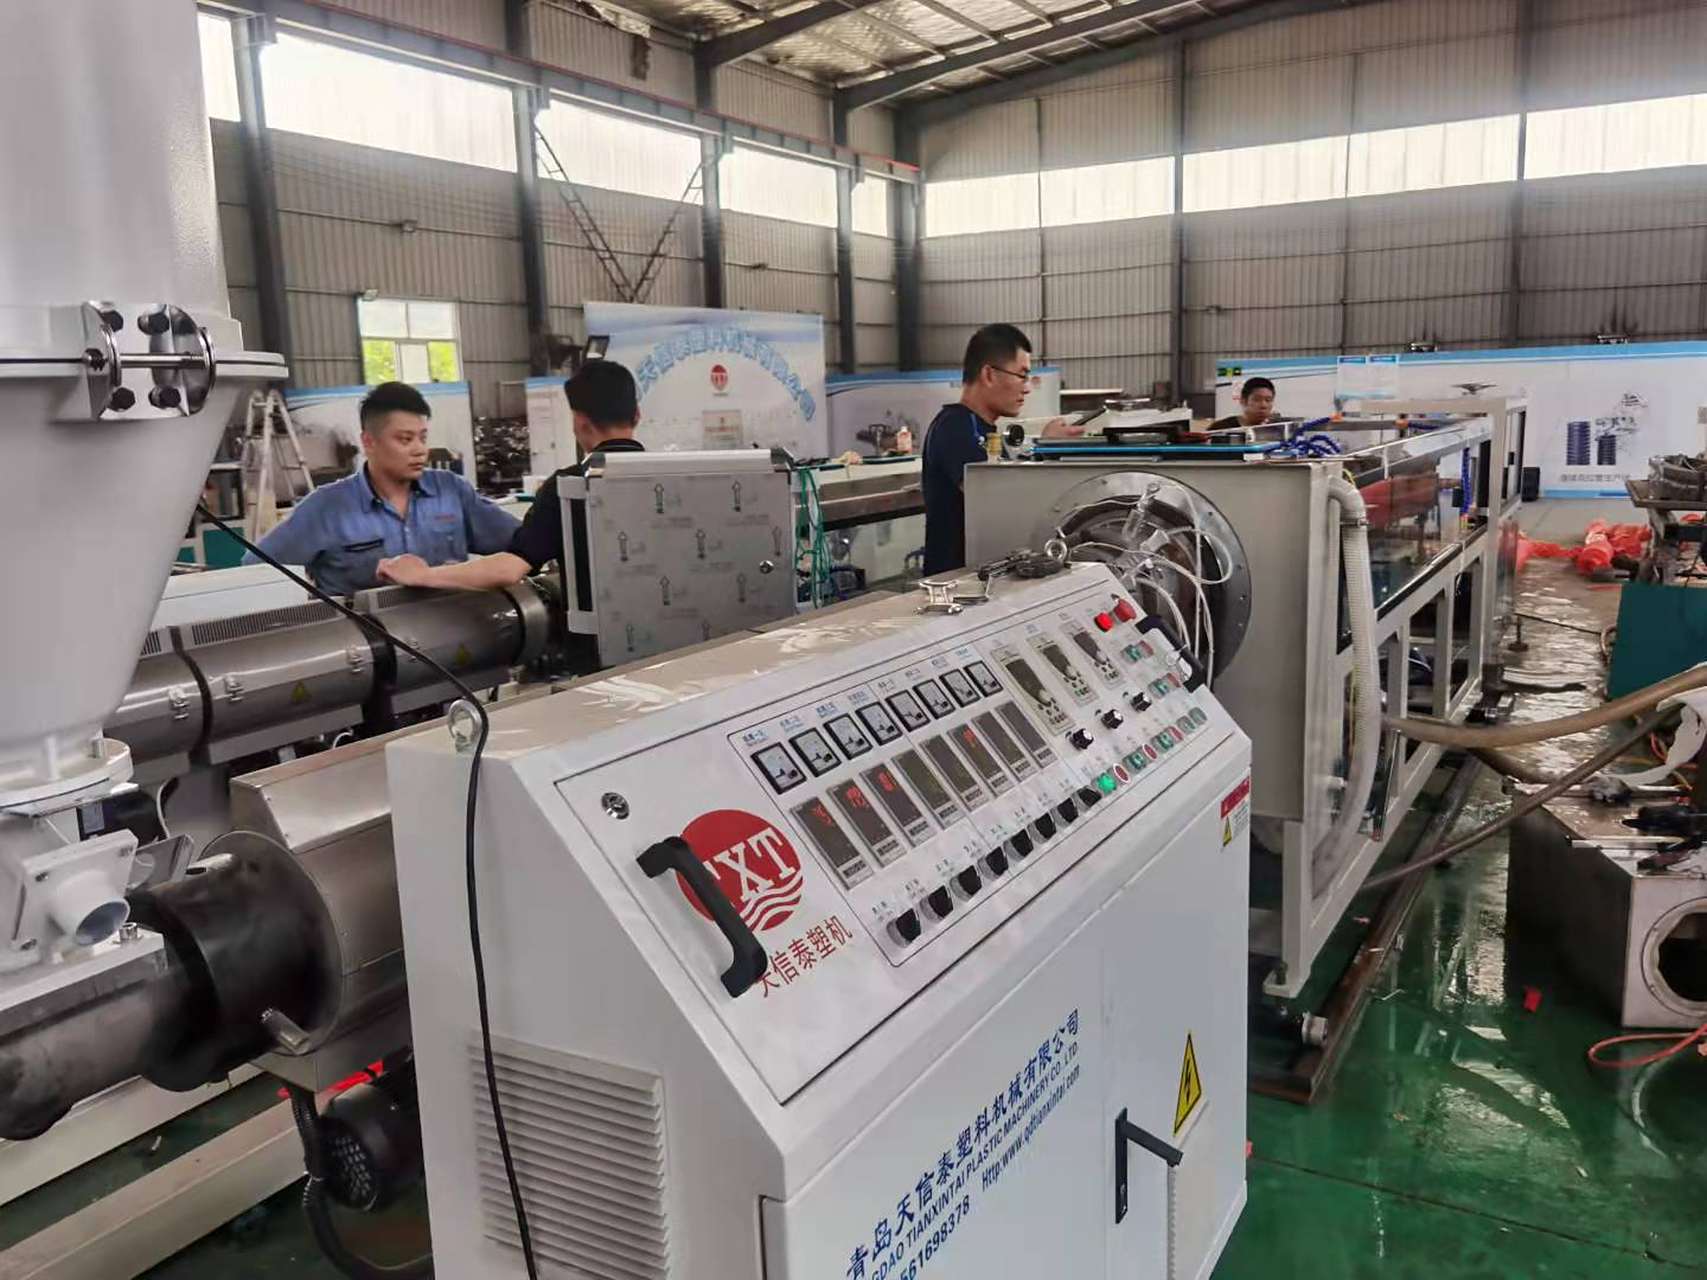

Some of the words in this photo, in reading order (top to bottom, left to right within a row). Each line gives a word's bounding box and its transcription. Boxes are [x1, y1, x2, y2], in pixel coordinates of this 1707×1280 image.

[846, 1008, 1079, 1280] 青岛天信泰塑料机械有限公司
[906, 1171, 965, 1248] TIANXINTAI
[966, 1128, 1003, 1179] PLASTIC
[1003, 1072, 1050, 1137] MACHINERY
